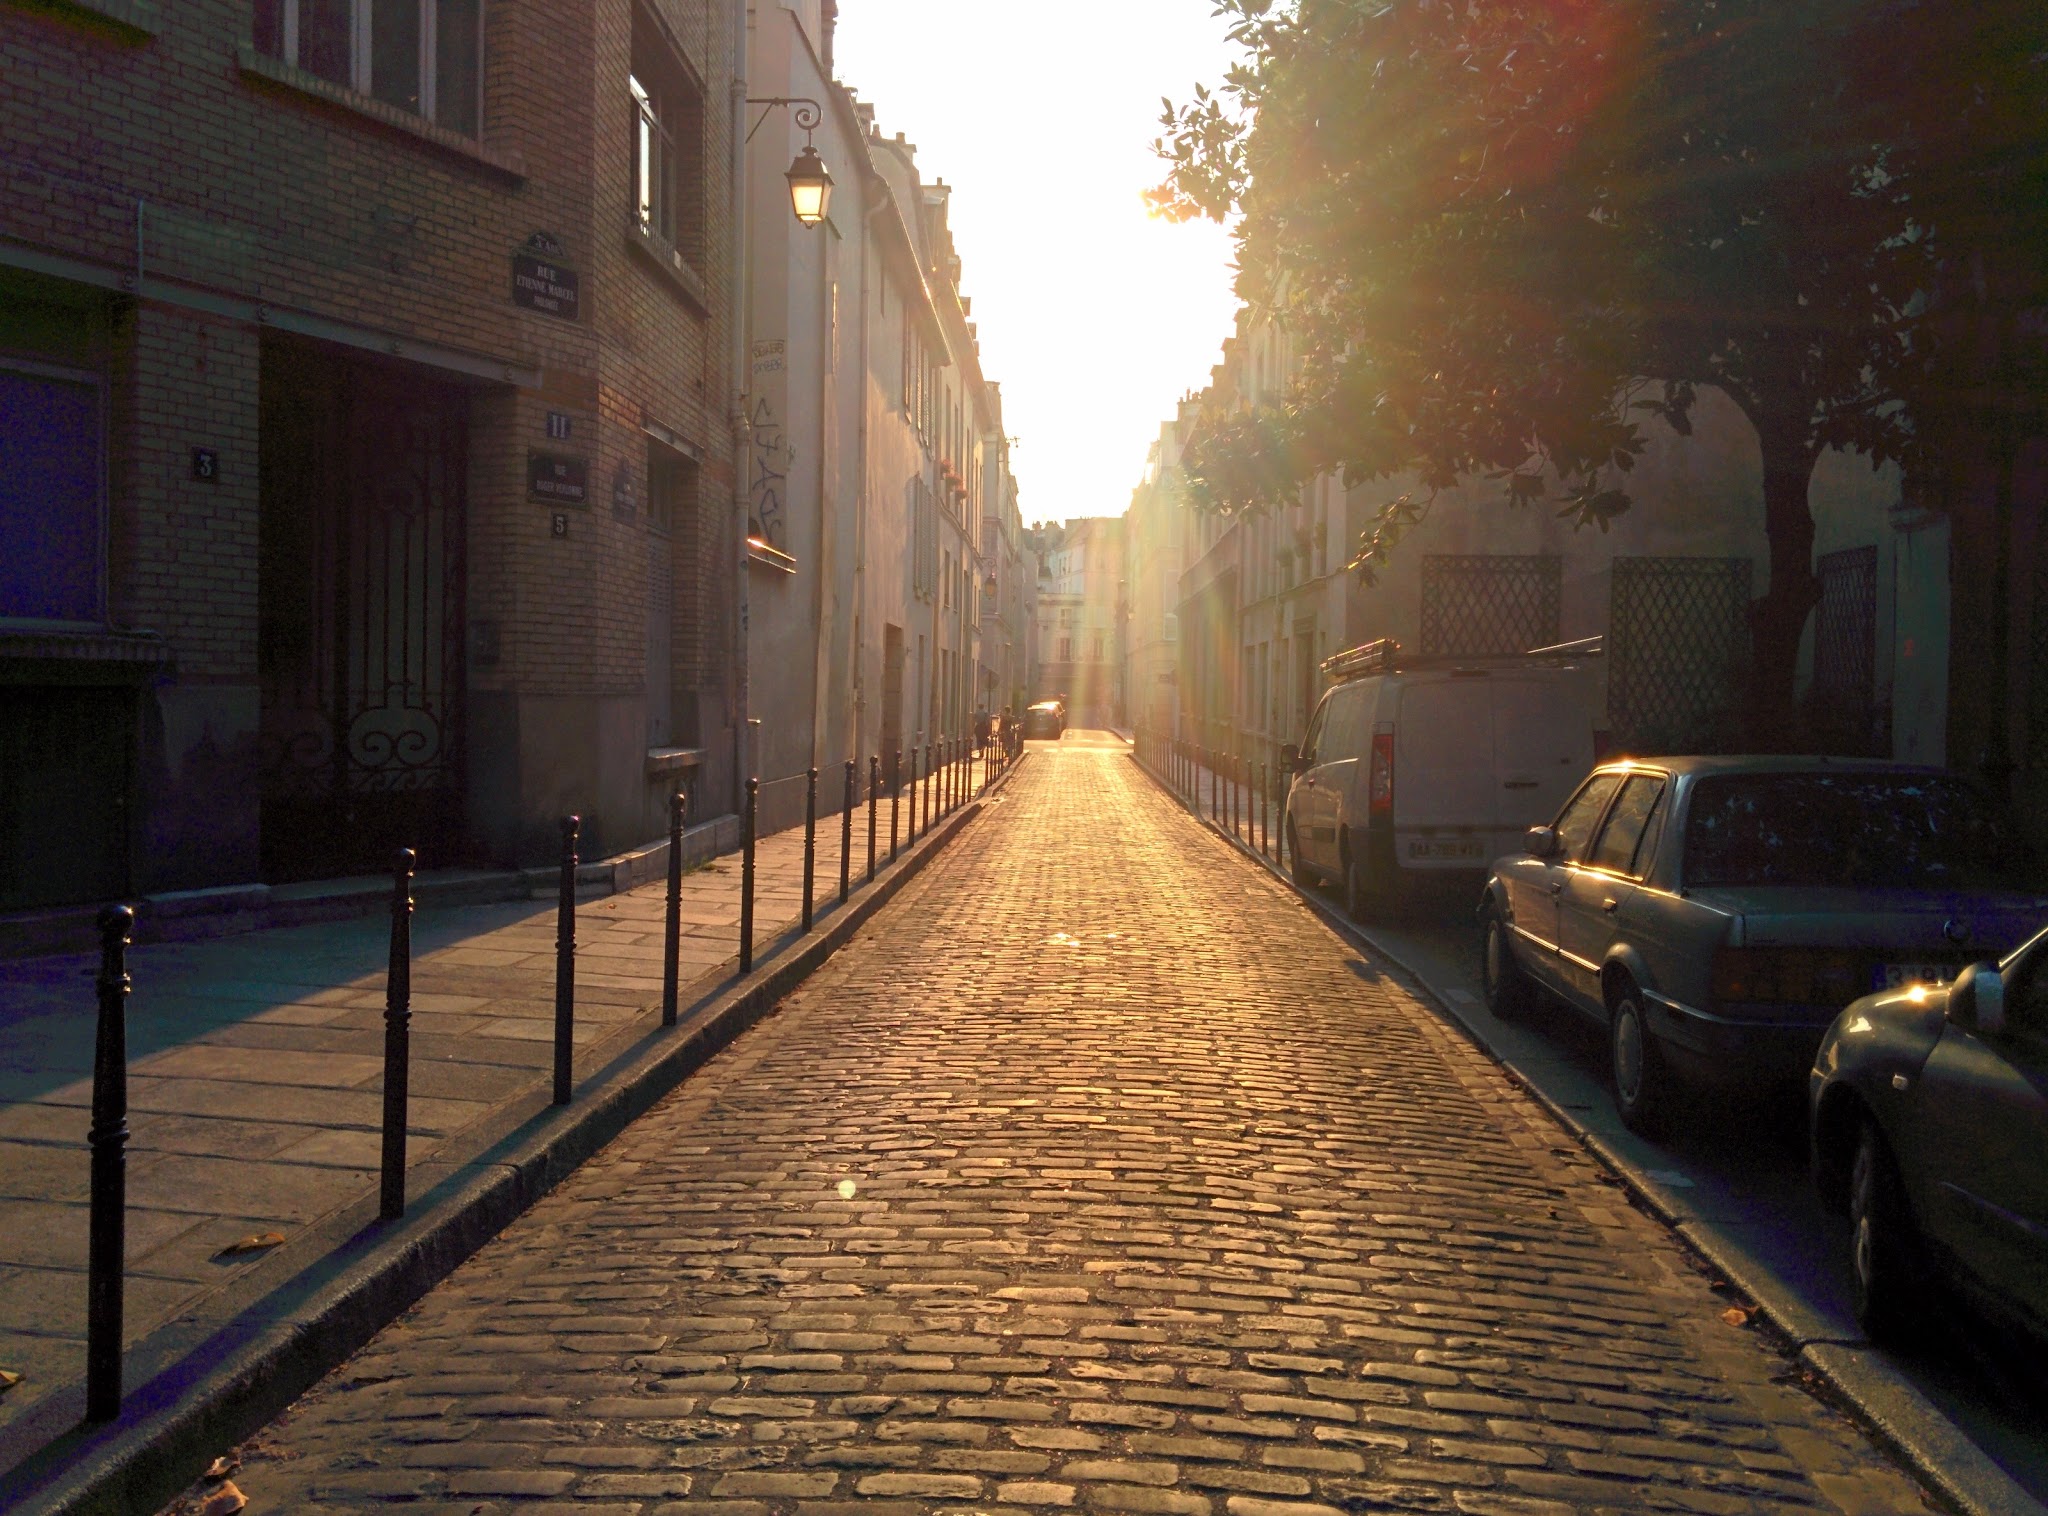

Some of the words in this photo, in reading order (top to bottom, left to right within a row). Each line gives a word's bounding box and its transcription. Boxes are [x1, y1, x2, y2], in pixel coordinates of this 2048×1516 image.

[537, 265, 557, 282] RUE
[548, 283, 575, 302] MARCEL
[552, 415, 566, 438] 11
[200, 453, 212, 476] 3
[555, 516, 565, 533] 5
